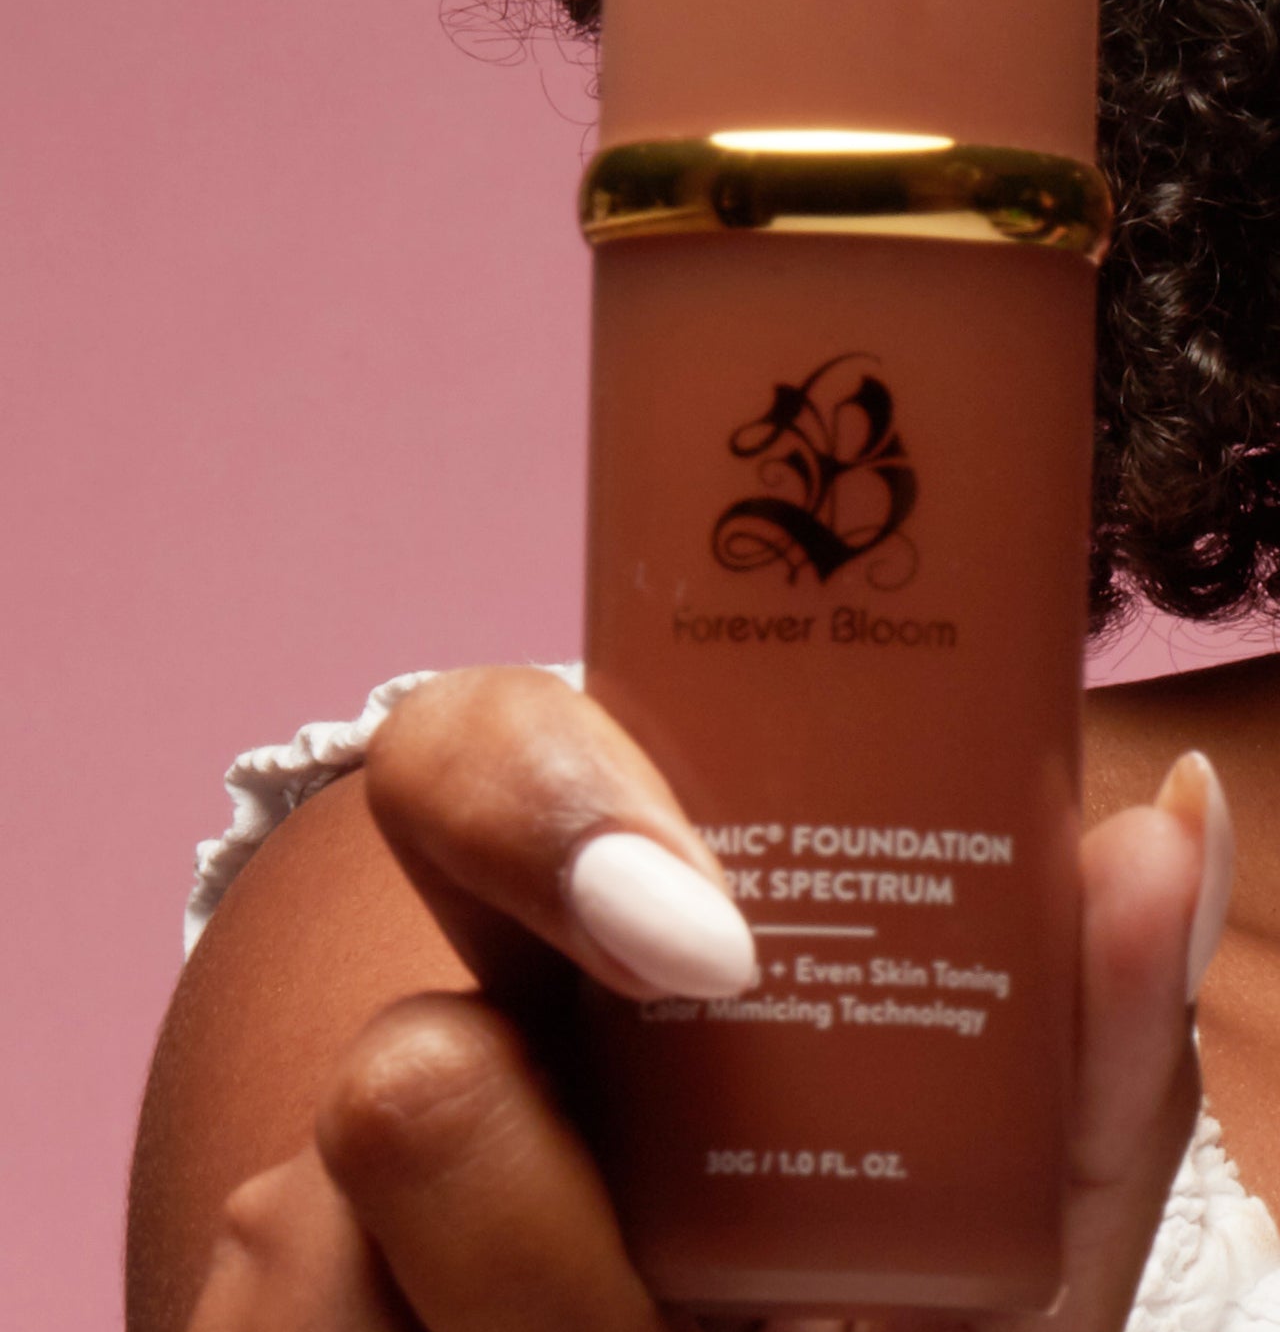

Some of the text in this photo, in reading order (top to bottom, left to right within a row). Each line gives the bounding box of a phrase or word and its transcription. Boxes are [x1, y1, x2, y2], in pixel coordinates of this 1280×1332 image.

[671, 605, 958, 649] Forever Bloom
[791, 826, 1013, 864] FOUNDATION
[769, 871, 954, 906] SPECTRUM
[794, 956, 864, 985] Even
[868, 957, 929, 988] Skin
[931, 961, 1011, 1000] Toning
[706, 995, 834, 1030] Mimicing
[838, 996, 986, 1036] Technology
[706, 1149, 756, 1176] 30G
[777, 1151, 815, 1176] 1.0
[819, 1152, 859, 1179] FL.
[861, 1152, 908, 1180] OZ.
